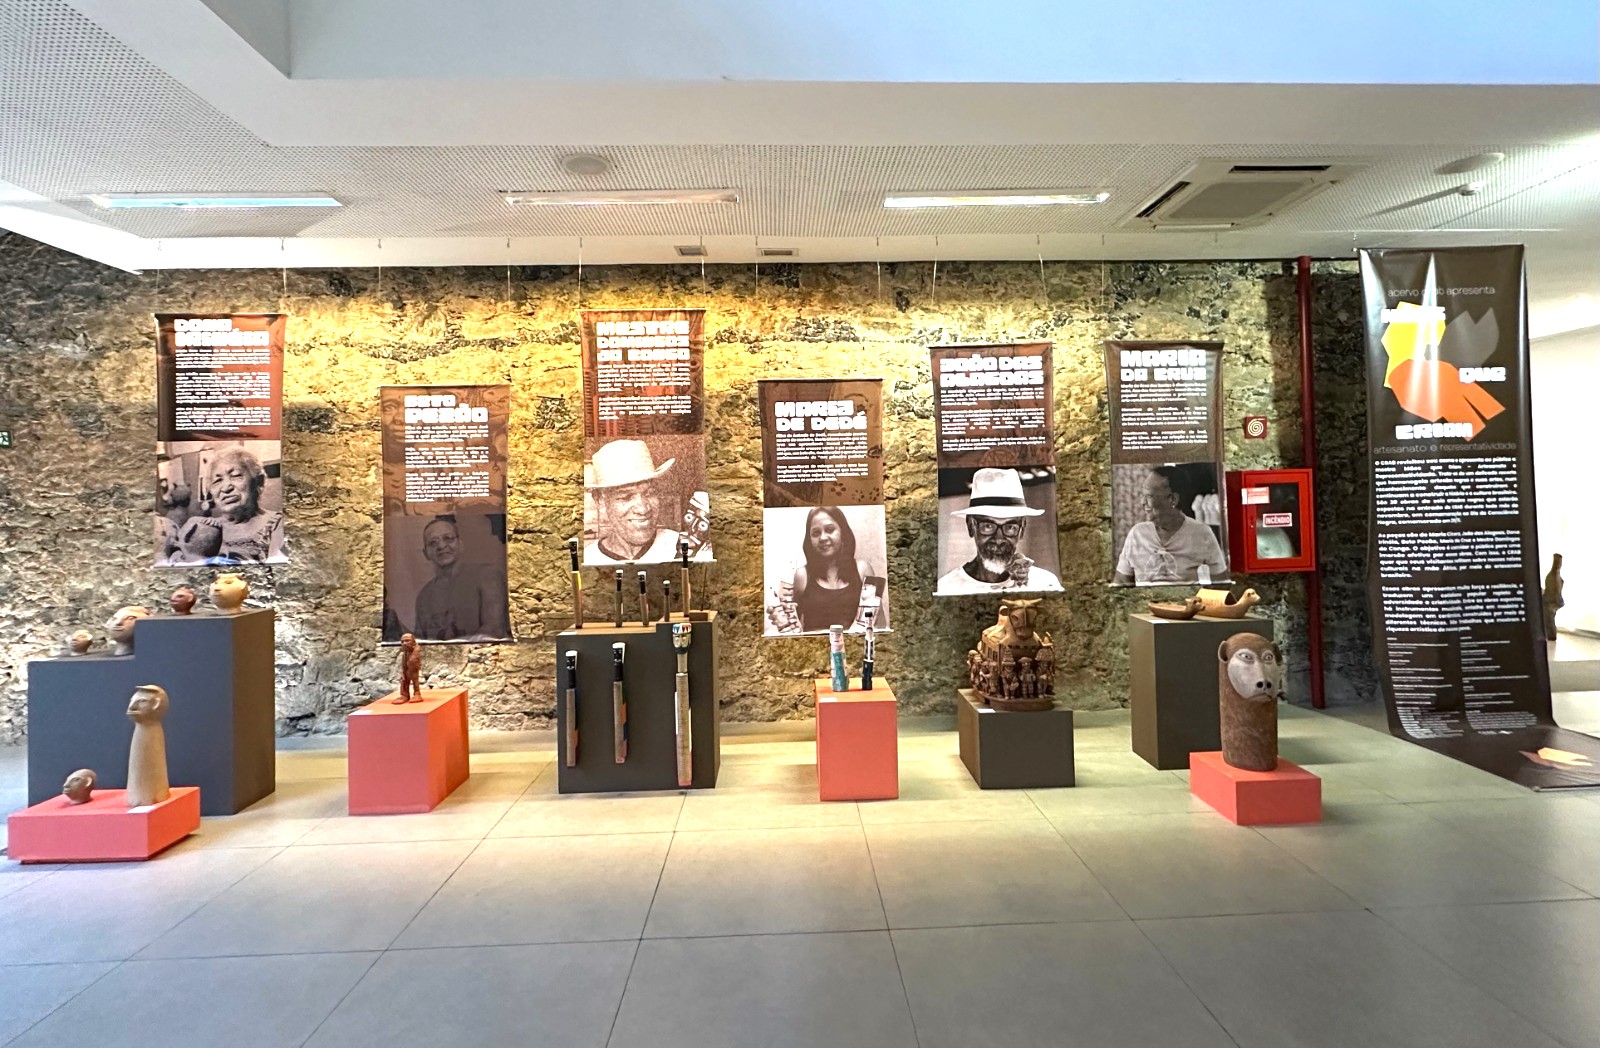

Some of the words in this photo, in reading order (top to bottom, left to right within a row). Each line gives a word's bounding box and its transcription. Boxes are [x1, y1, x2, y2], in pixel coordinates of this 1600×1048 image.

[1388, 289, 1419, 297] acervo
[1446, 286, 1496, 297] apresenta
[596, 321, 690, 336] MESTRE
[940, 354, 997, 372] JOÃO
[998, 356, 1042, 370] DAS
[1120, 350, 1206, 367] MARIA
[940, 370, 1044, 388] ALAGOAS
[1120, 368, 1148, 382] DA
[1154, 368, 1207, 381] CRUZ
[1459, 366, 1506, 383] QUE
[775, 400, 854, 417] MARIA
[776, 417, 804, 431] DE
[1395, 422, 1473, 439] CRIAM
[1374, 444, 1427, 454] artesanato
[1440, 442, 1517, 452] representatividade
[1266, 516, 1290, 524] INCÊNDIO
